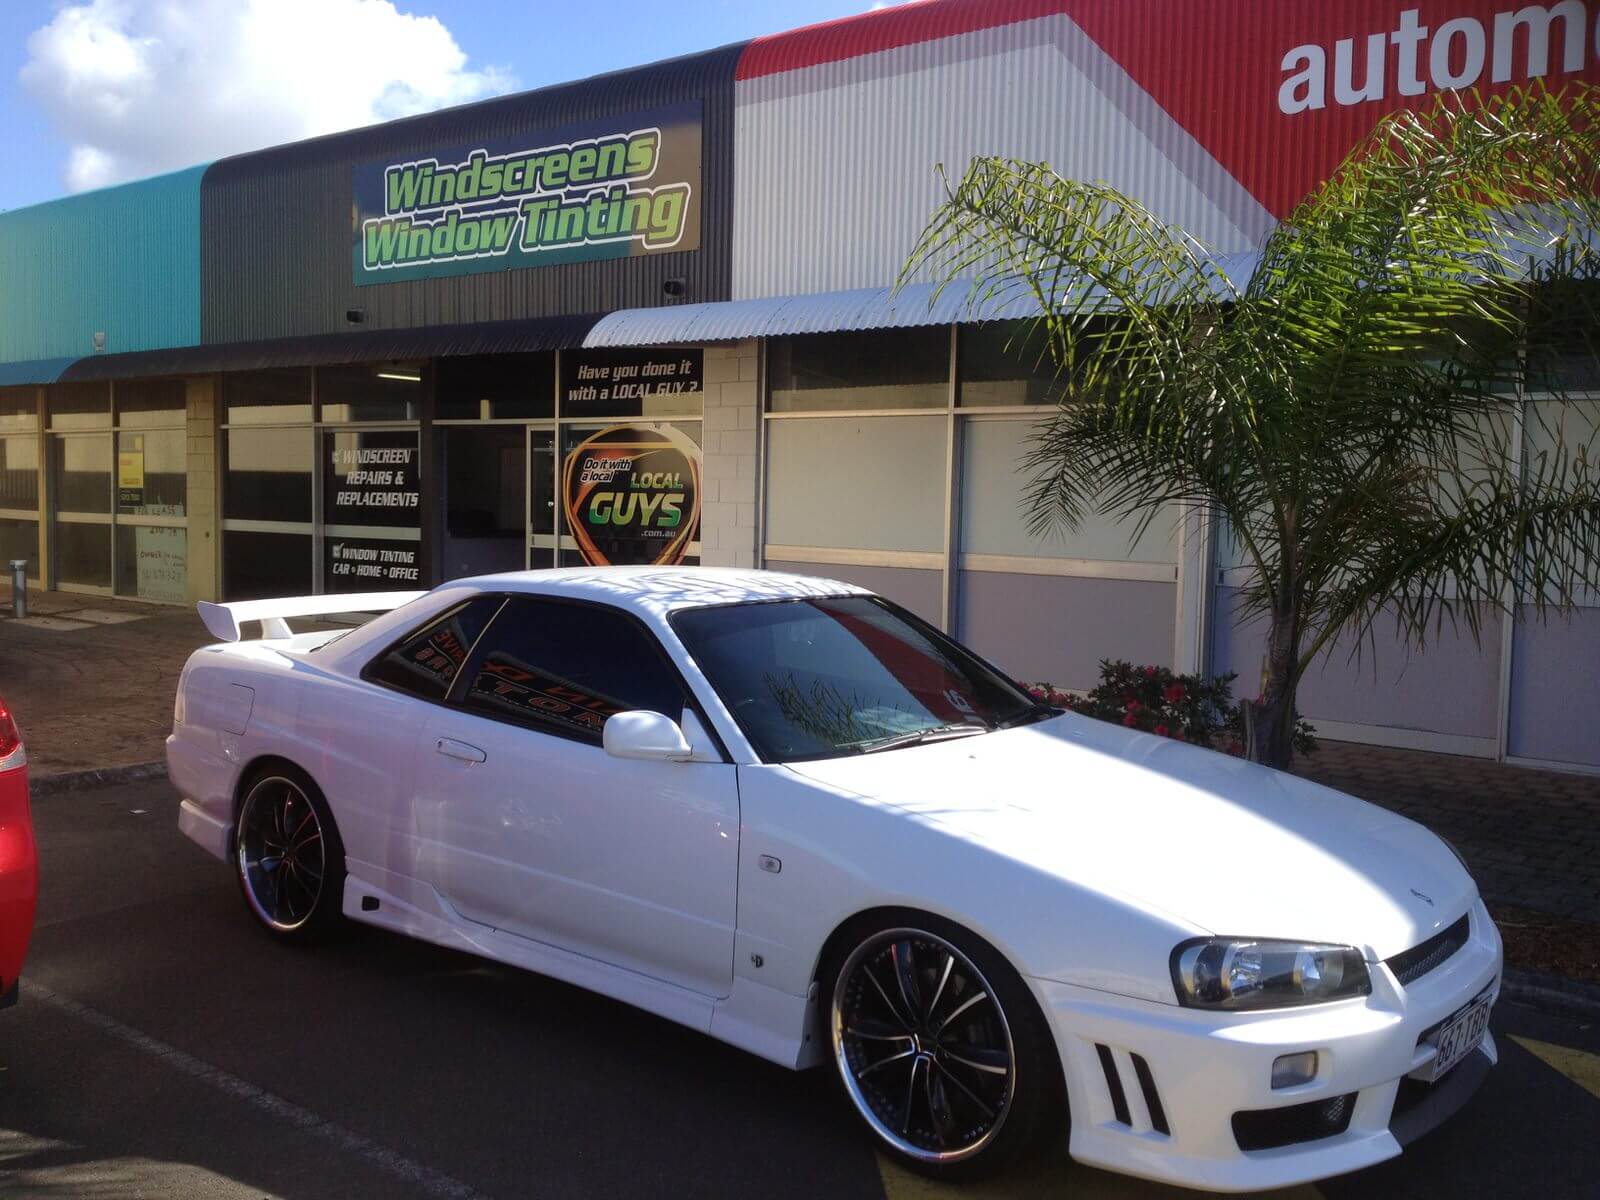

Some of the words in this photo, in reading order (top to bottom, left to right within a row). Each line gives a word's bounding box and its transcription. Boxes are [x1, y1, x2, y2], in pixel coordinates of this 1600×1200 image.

[1278, 0, 1600, 115] autom
[387, 131, 659, 213] Windscreens
[365, 211, 519, 266] Window
[521, 186, 688, 249] Tinting
[577, 365, 609, 380] Have
[612, 365, 638, 381] you
[642, 361, 676, 376] done
[679, 360, 692, 375] it
[568, 386, 596, 400] with
[600, 388, 609, 400] a
[612, 383, 650, 399] LOCAL
[656, 382, 684, 397] GUY
[689, 381, 698, 394] ?
[343, 449, 411, 464] WINDSCREEN
[583, 458, 598, 470] Do
[600, 458, 608, 470] it
[608, 458, 632, 471] with
[346, 470, 393, 485] REPAIRS
[395, 470, 404, 485] &
[581, 473, 590, 482] a
[590, 471, 615, 482] local
[630, 472, 683, 489] LOCAL
[336, 491, 419, 507] REPLACEMENTS
[588, 492, 685, 527] GUYS
[343, 547, 379, 560] WINDOW
[380, 550, 414, 563] TINTING
[332, 562, 350, 574] CAR
[356, 565, 382, 577] HOME
[389, 567, 419, 580] OFFICE
